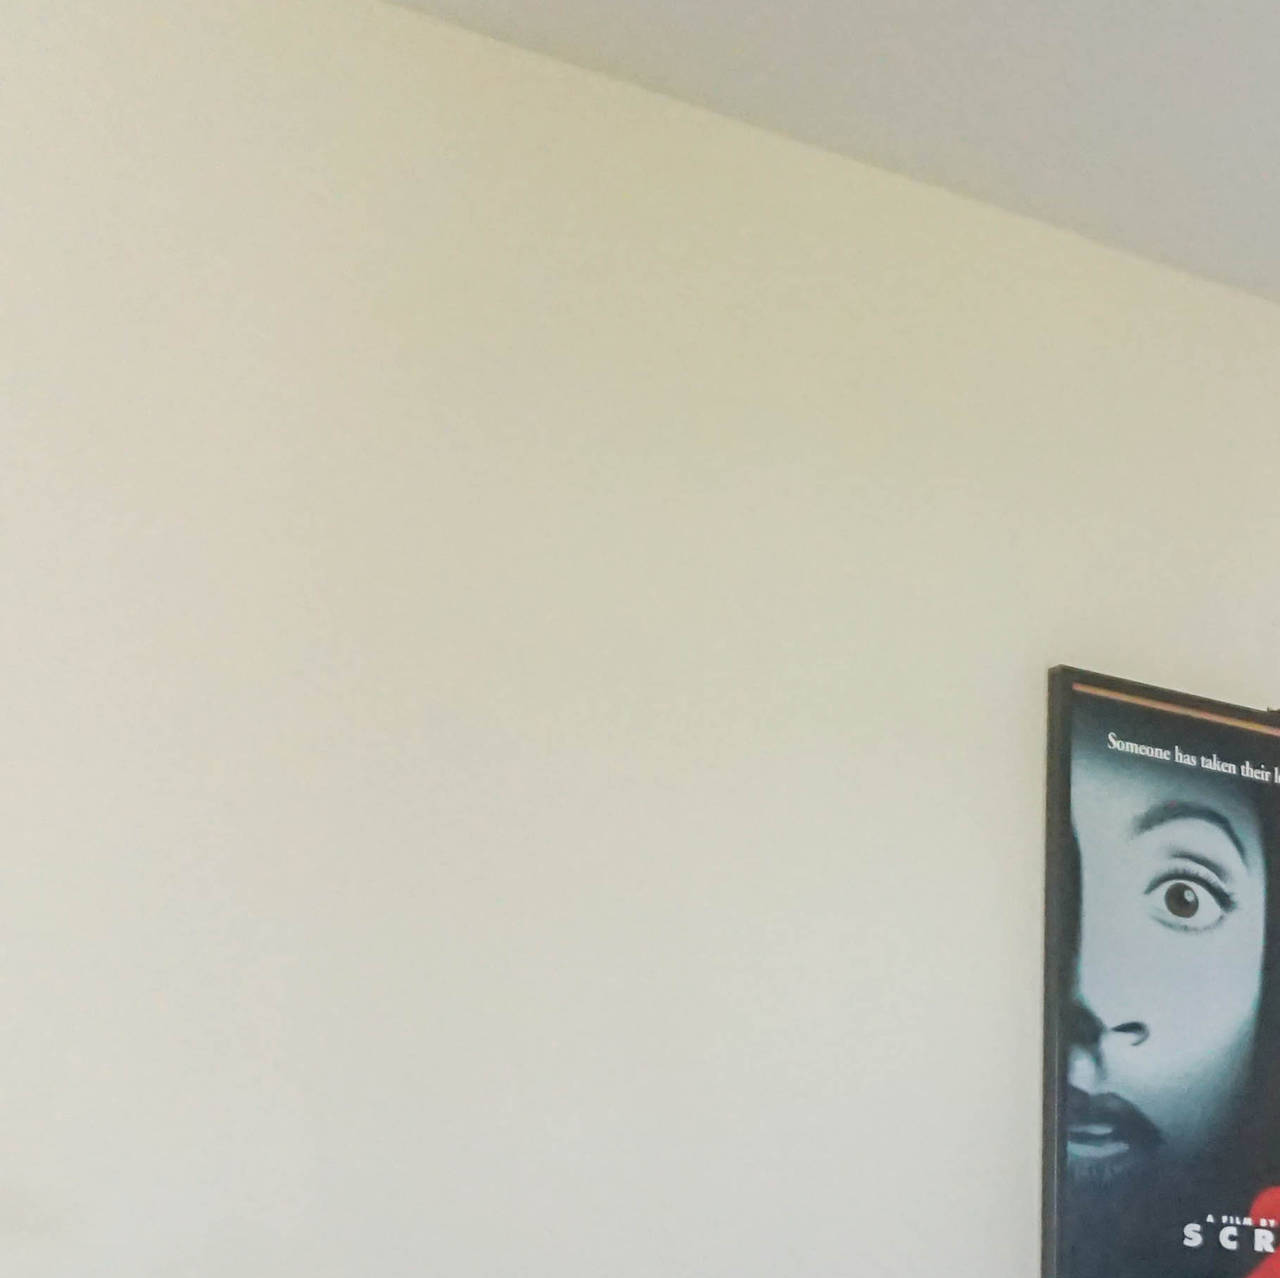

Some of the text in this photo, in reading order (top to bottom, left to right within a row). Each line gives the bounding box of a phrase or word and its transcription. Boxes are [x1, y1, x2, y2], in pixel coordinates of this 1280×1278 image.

[1107, 732, 1171, 761] Someone
[1175, 746, 1197, 766] has
[1200, 754, 1237, 775] taken
[1240, 760, 1271, 782] their
[1206, 1214, 1214, 1223] A
[1221, 1216, 1253, 1226] FILM
[1260, 1218, 1275, 1228] BY
